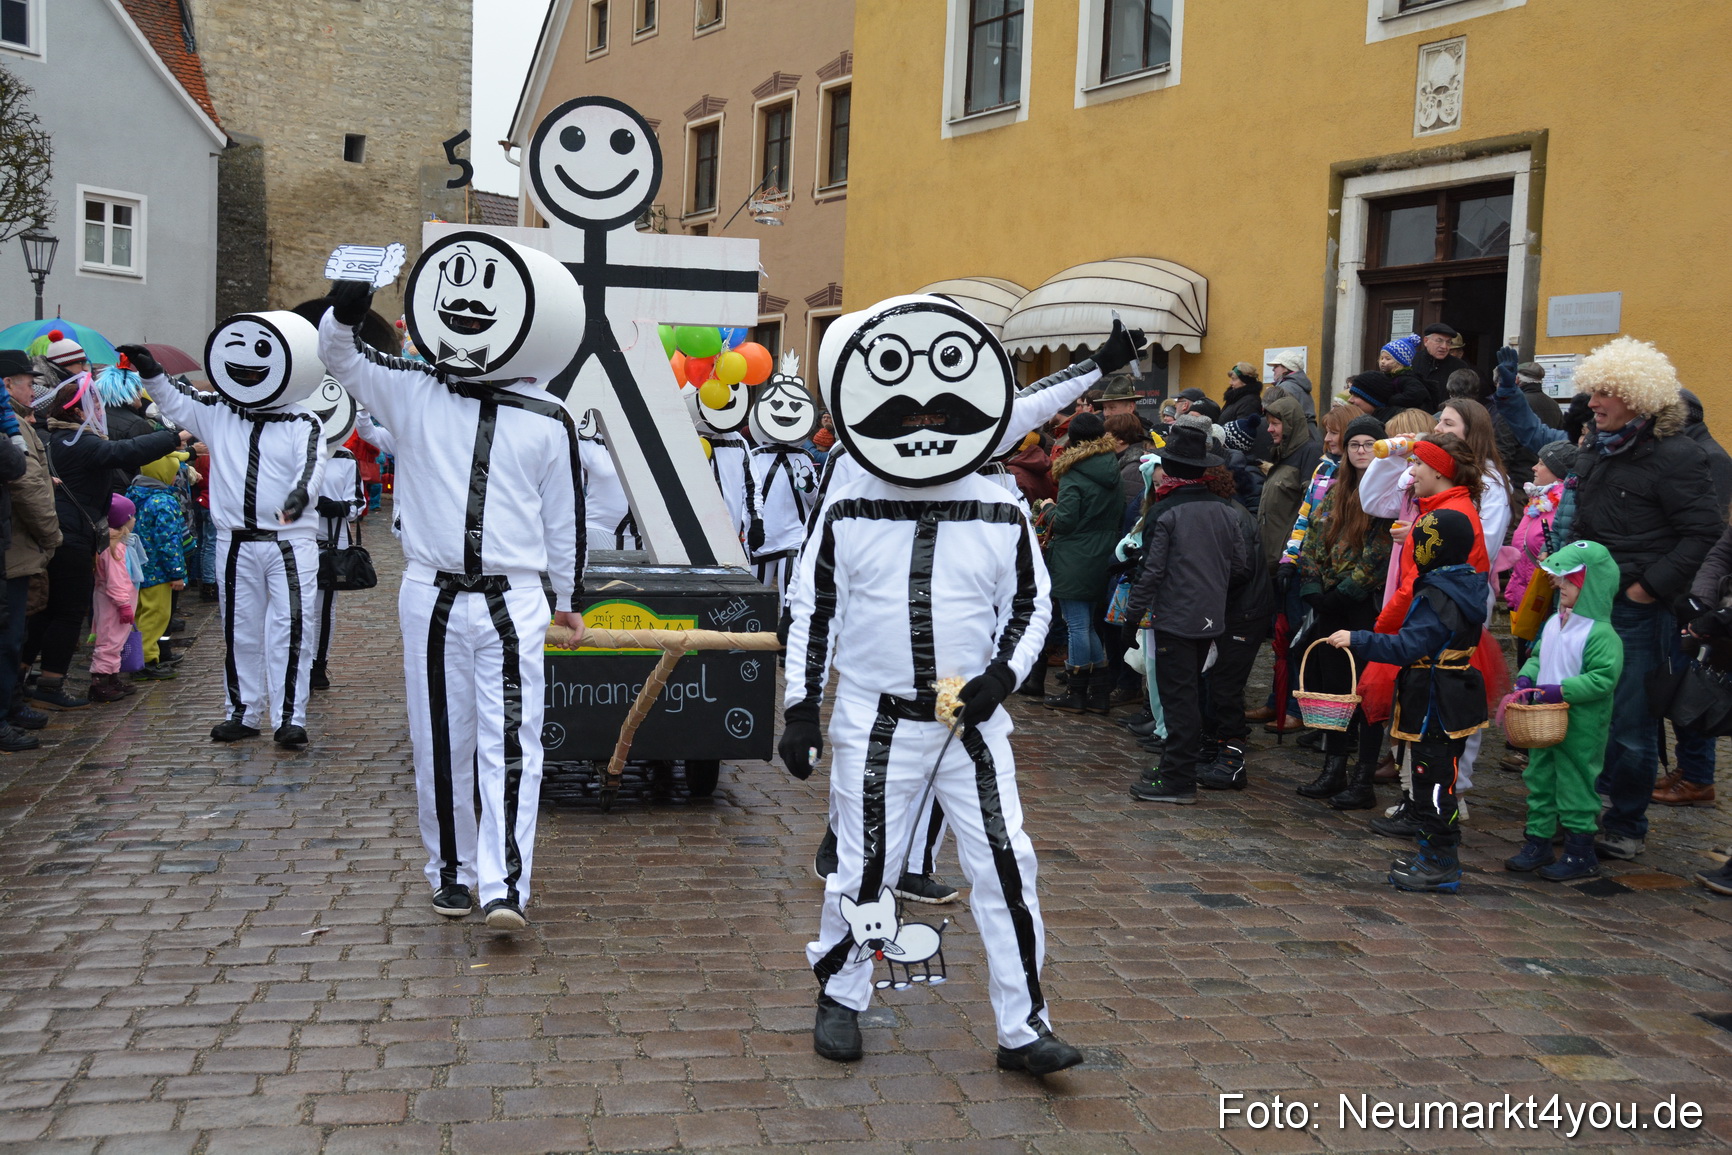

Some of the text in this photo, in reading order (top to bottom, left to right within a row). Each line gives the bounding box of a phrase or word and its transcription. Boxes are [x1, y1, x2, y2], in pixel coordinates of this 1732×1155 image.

[442, 128, 474, 189] 5
[593, 610, 642, 623] mir san
[708, 596, 750, 626] Hecht
